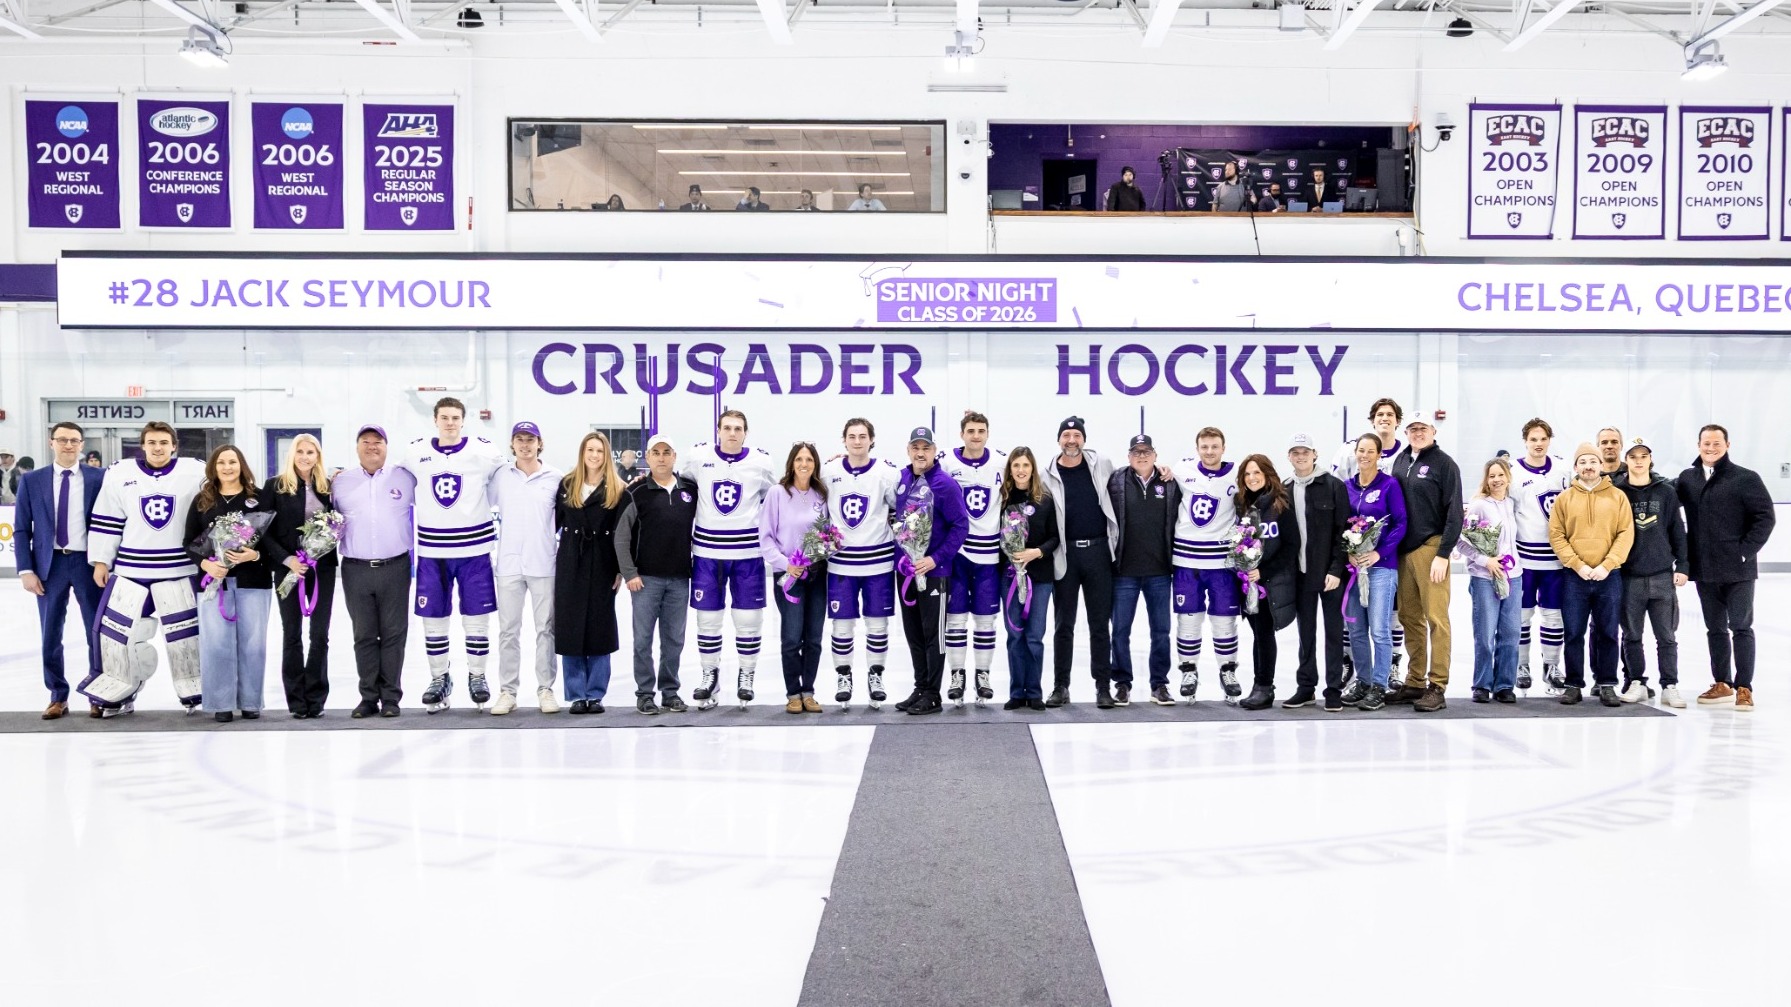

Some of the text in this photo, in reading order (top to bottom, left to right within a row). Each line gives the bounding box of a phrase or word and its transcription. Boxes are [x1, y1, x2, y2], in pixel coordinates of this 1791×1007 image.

[162, 114, 196, 123] atlantic
[59, 120, 87, 130] NCAA
[159, 120, 192, 131] hockey
[284, 122, 313, 132] NCAA
[1487, 116, 1544, 136] ECAC
[1592, 118, 1649, 137] ECAC
[1697, 118, 1754, 137] ECAC
[36, 142, 109, 165] 2004
[148, 142, 220, 165] 2006
[262, 144, 334, 166] 2006
[374, 146, 443, 168] 2025
[1482, 151, 1548, 172] 2003
[1587, 153, 1653, 173] 2009
[1697, 153, 1753, 173] 2010
[56, 171, 90, 182] WEST
[146, 170, 223, 182] CONFERENCE
[281, 173, 315, 183] WEST
[381, 170, 436, 180] REGULAR
[44, 184, 103, 195] REGIONAL
[149, 184, 220, 195] CHAMPIONS
[385, 181, 433, 191] SEASON
[1496, 179, 1533, 190] OPEN
[1601, 181, 1637, 191] OPEN
[1706, 181, 1743, 191] OPEN
[268, 185, 328, 196] REGIONAL
[373, 192, 445, 203] CHAMPIONS
[1474, 195, 1554, 206] CHAMPIONS
[1580, 196, 1659, 207] CHAMPIONS
[1685, 196, 1763, 207] CHAMPIONS
[108, 279, 492, 308] #28 JACK SEYMOUR
[880, 282, 1053, 302] SENIOR NIGHT
[1457, 282, 1791, 316] CHELSEA, QUEBE
[897, 306, 1037, 322] CLASS OF 2026
[531, 342, 1349, 396] CRUSADER HOCKEY
[128, 386, 142, 396] EXIT
[995, 472, 1002, 485] A
[1227, 485, 1235, 496] C
[1259, 521, 1279, 538] 20
